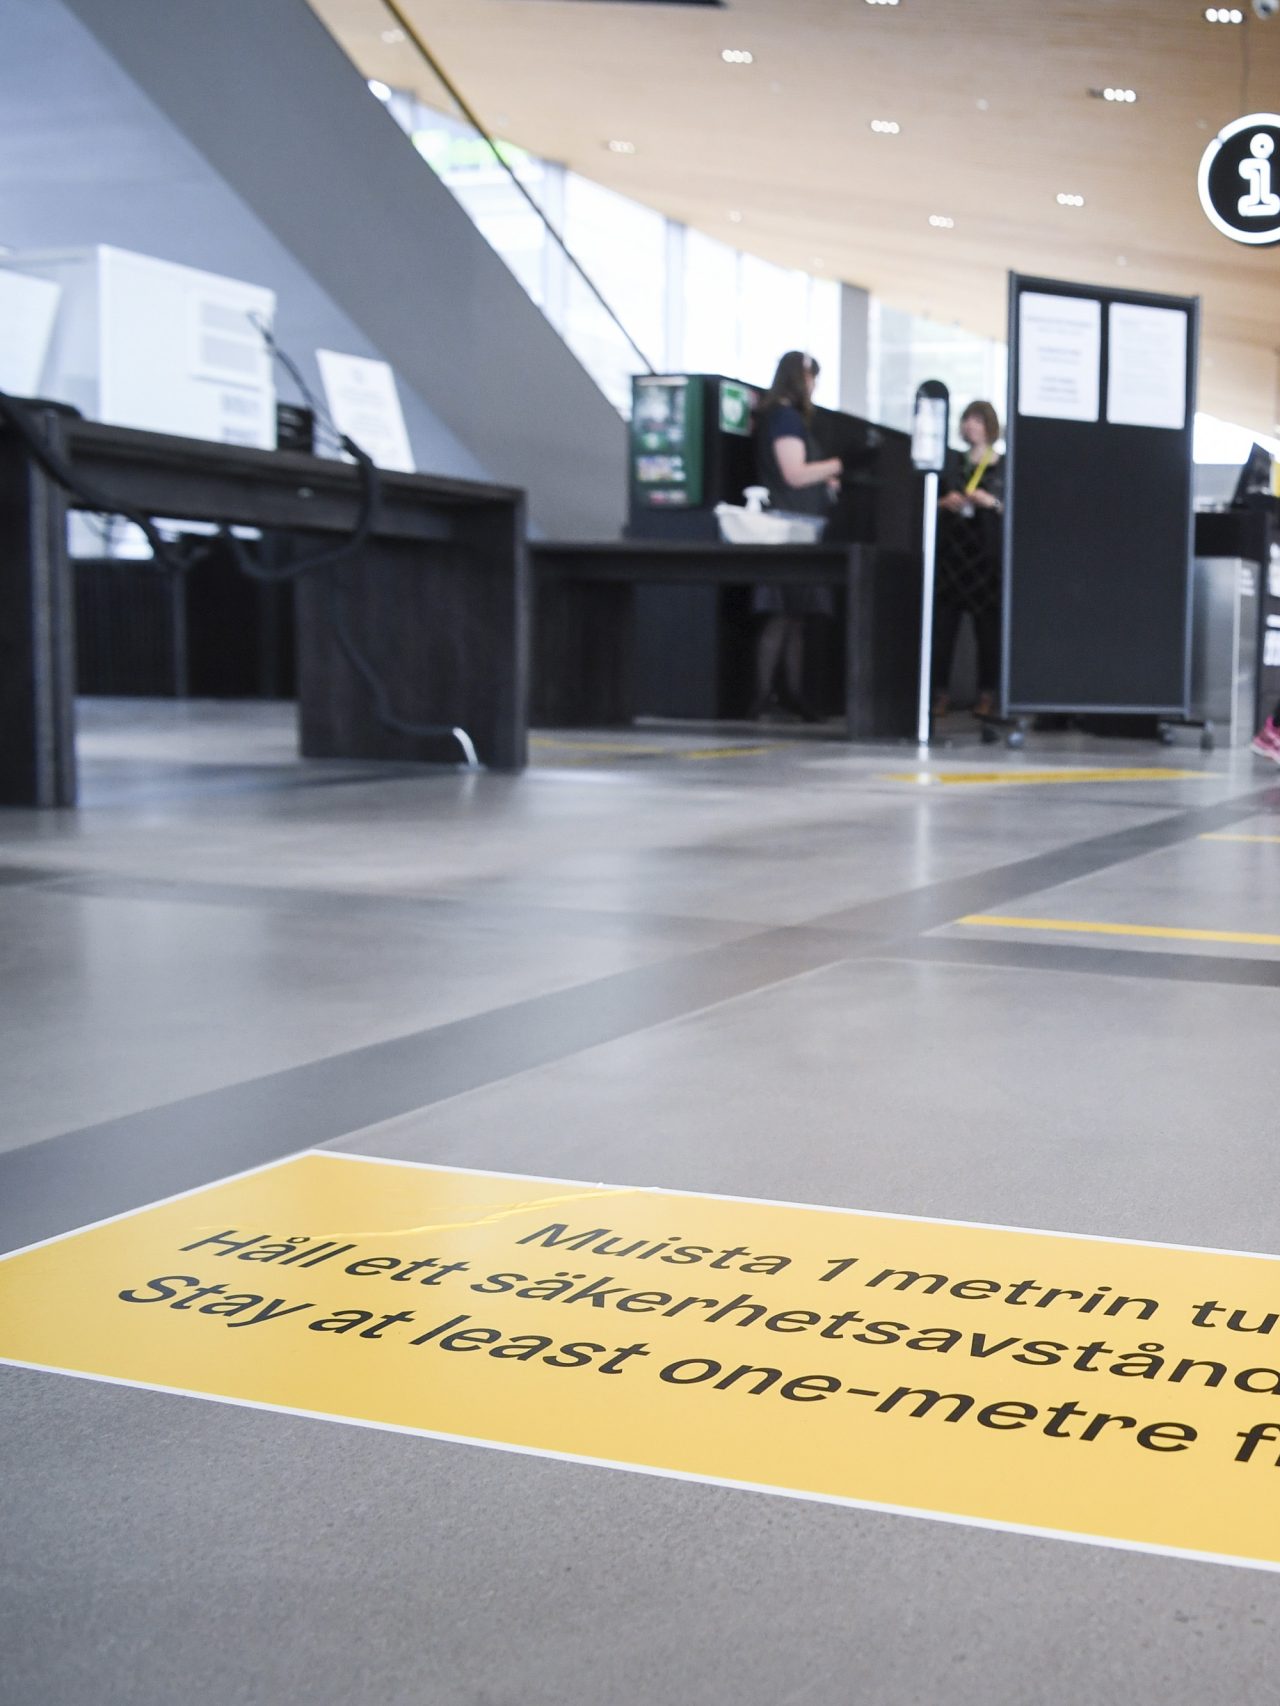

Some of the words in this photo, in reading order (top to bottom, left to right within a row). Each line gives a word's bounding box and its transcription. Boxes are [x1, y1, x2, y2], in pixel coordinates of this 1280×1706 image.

[178, 1229, 358, 1268] Håll
[343, 1257, 470, 1286] ett
[515, 1222, 792, 1276] Muista
[817, 1256, 860, 1283] 1
[865, 1268, 1160, 1322] metrin
[117, 1274, 316, 1329] Stay
[307, 1308, 417, 1340] at
[407, 1313, 652, 1376] least
[658, 1357, 1199, 1453] one-metre
